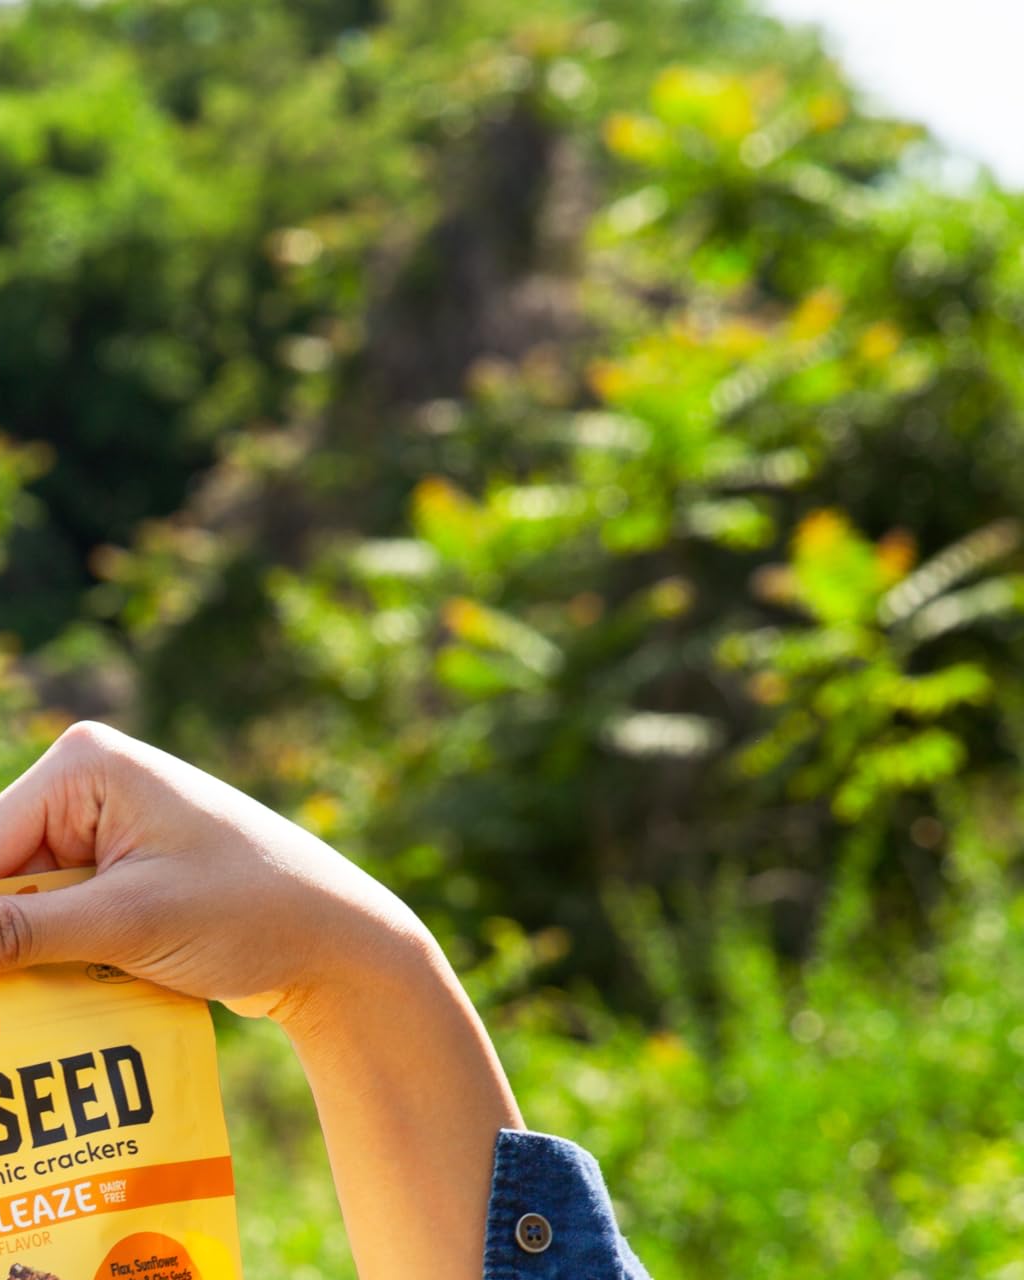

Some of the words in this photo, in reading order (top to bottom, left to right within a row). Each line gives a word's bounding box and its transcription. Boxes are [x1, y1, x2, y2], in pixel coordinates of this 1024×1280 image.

[33, 1138, 139, 1178] crackers
[99, 1179, 127, 1194] DAIRY
[103, 1190, 127, 1204] FREE
[110, 1262, 135, 1277] Flax,
